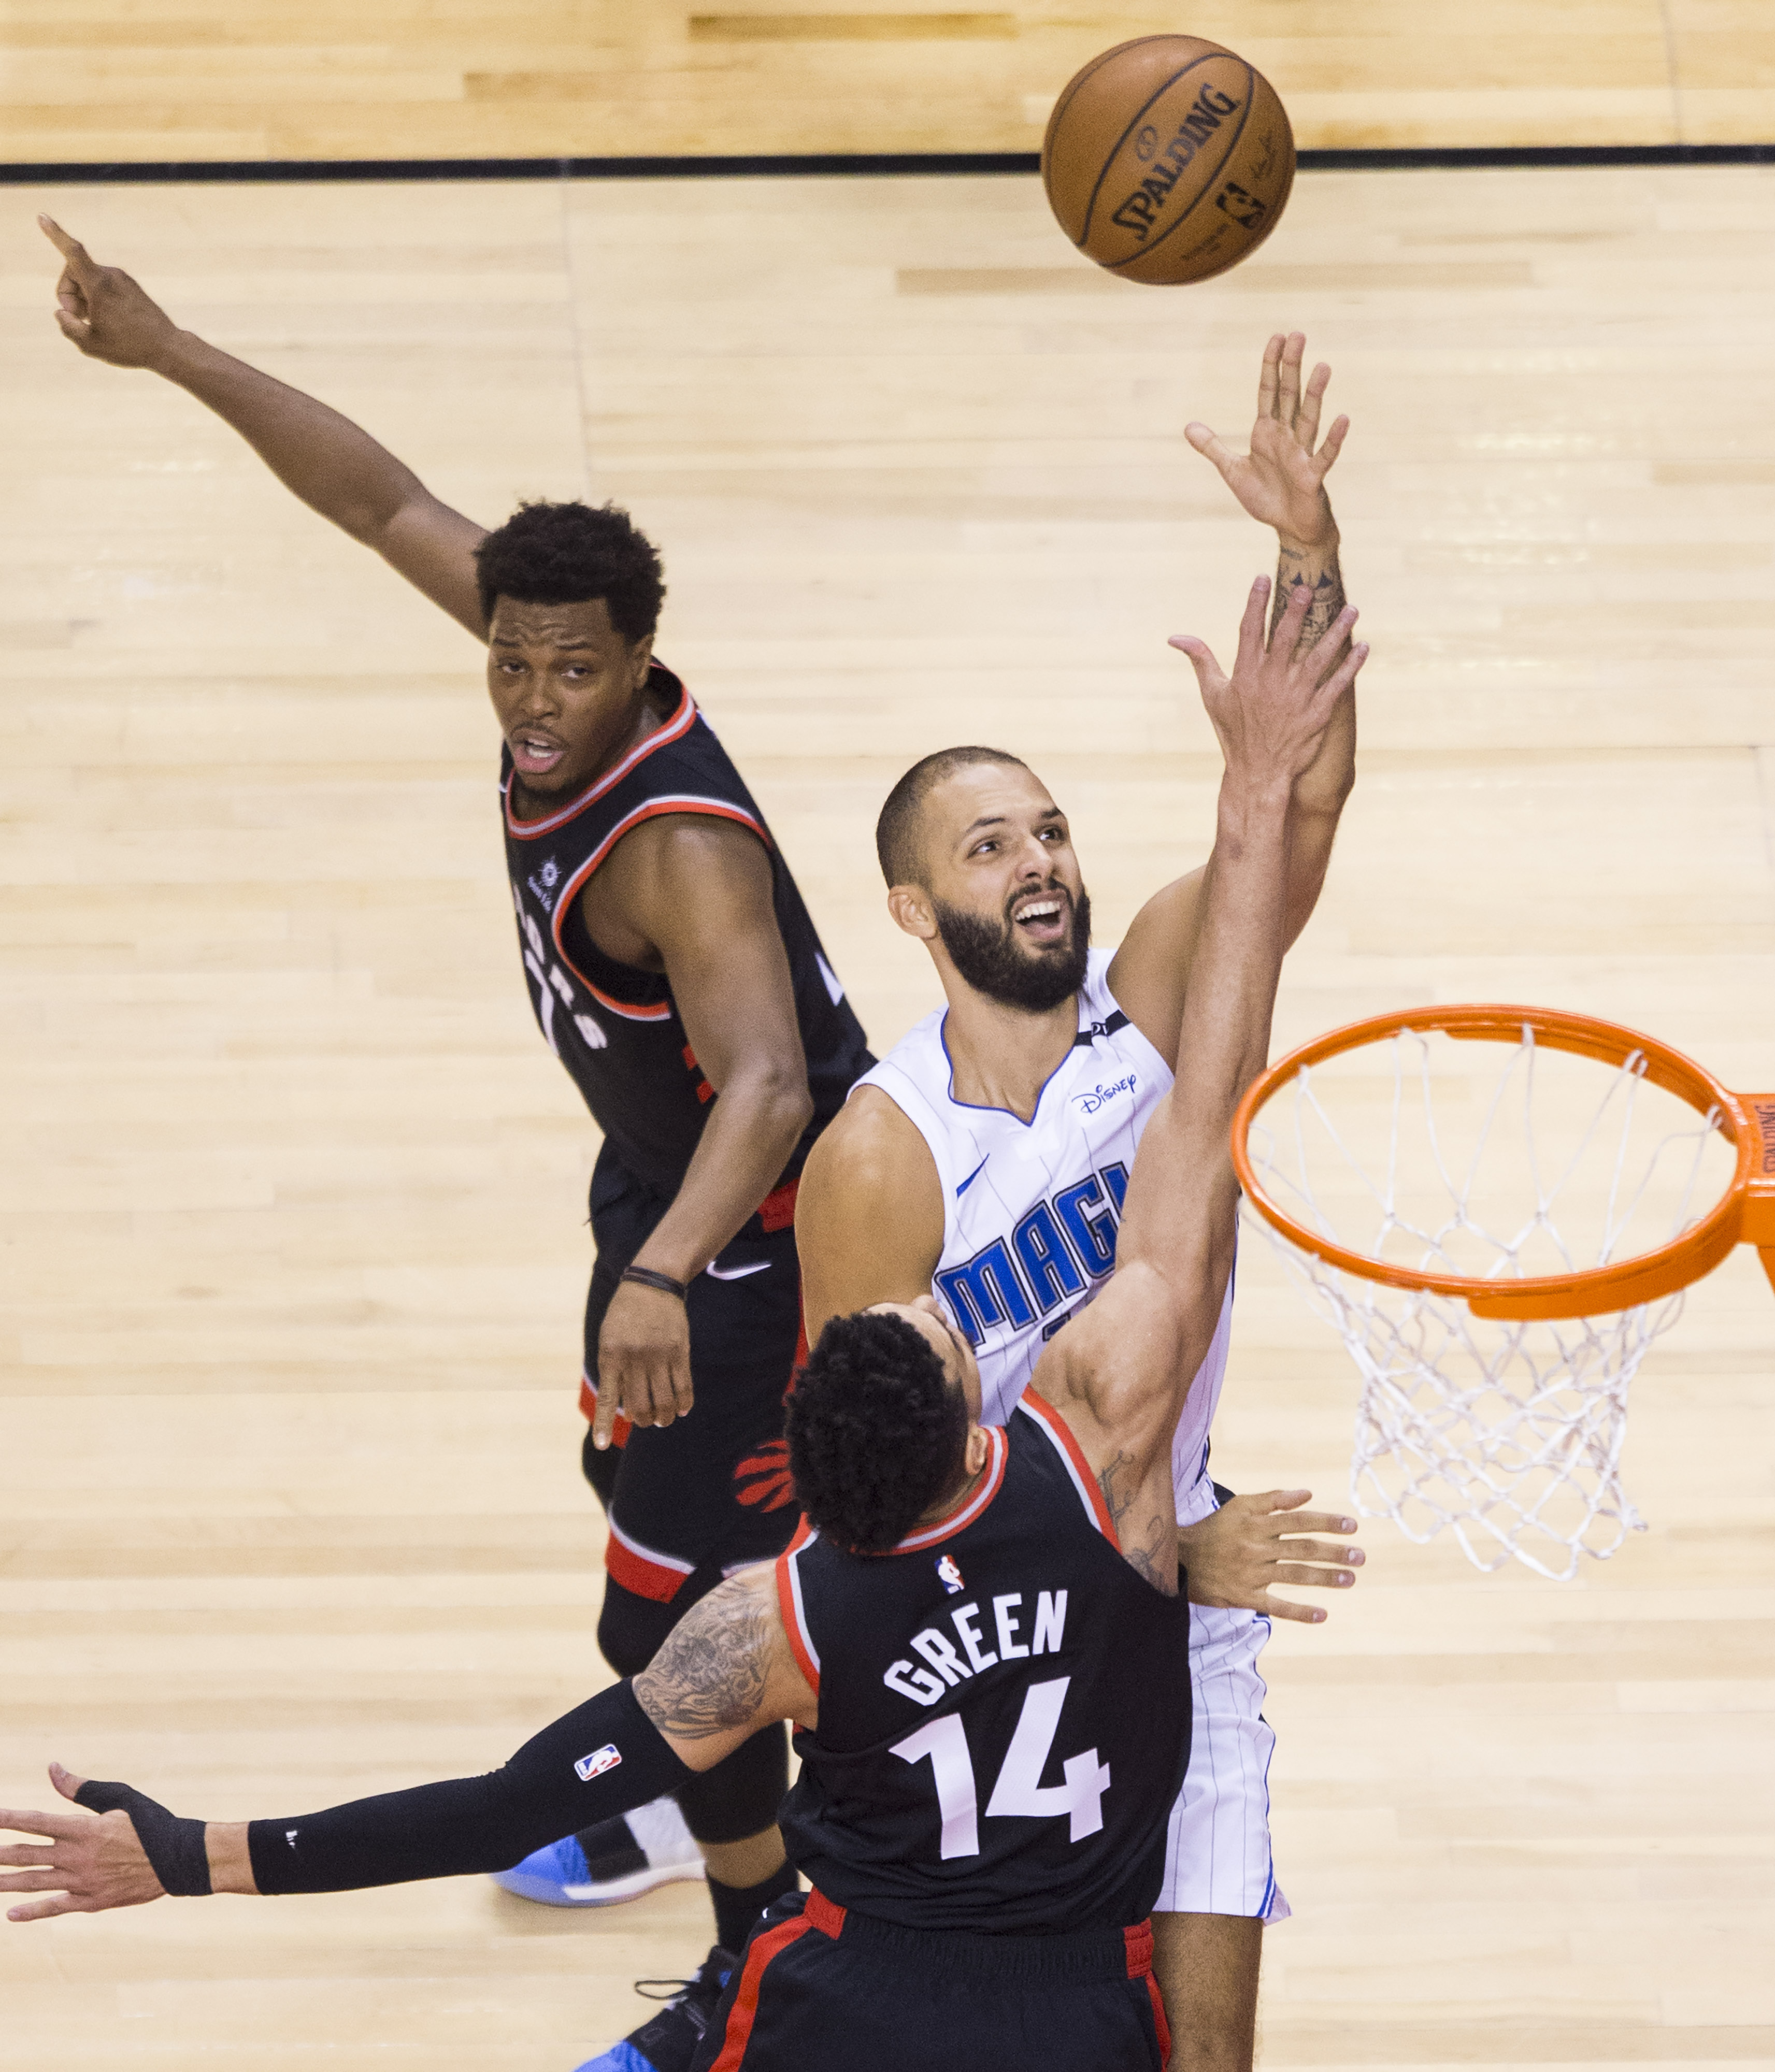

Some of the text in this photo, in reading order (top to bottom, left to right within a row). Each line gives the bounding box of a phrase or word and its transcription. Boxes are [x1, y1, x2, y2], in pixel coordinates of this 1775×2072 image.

[1111, 82, 1241, 241] SPALDING
[1071, 1074, 1136, 1114] Disney
[883, 1589, 1068, 1706] GREEN
[888, 1676, 1111, 1860] 14
